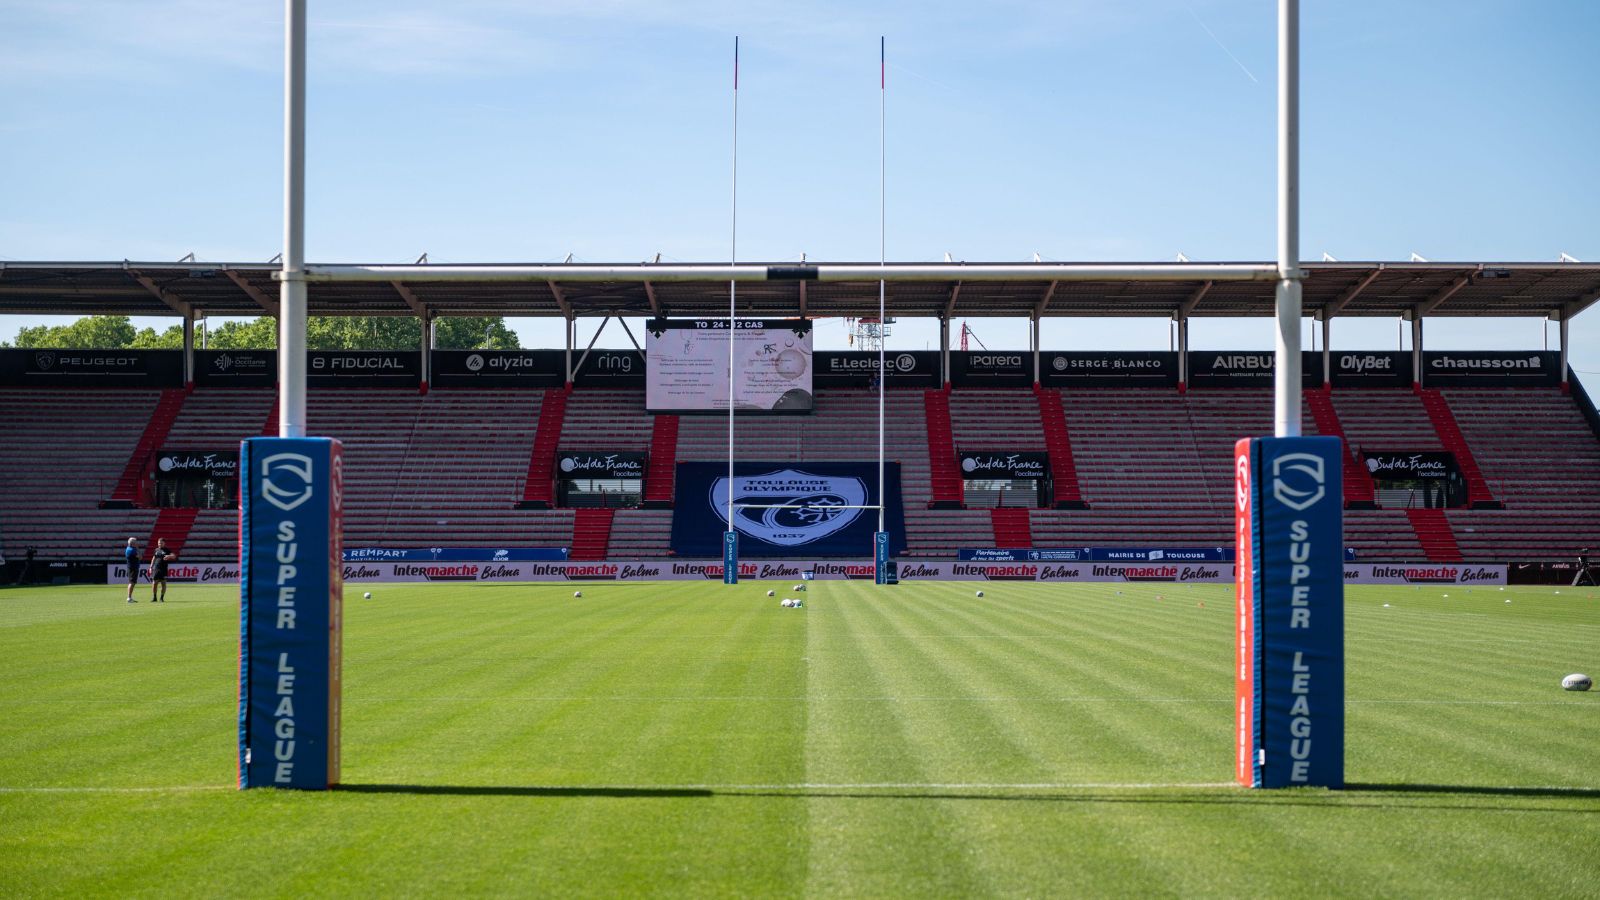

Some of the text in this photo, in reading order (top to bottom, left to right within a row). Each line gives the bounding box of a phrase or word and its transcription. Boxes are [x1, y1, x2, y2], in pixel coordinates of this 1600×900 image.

[59, 357, 138, 366] PEUGEOT
[331, 356, 405, 368] FIDUCIAL
[489, 355, 533, 370] alyzia
[598, 353, 632, 372] ring
[973, 356, 1022, 365] Parera
[1071, 359, 1161, 368] SERGE BLANCO
[1212, 356, 1275, 369] AIRBU
[1340, 355, 1391, 372] OlyBet
[1432, 356, 1529, 368] chausson
[172, 456, 190, 470] Sud
[573, 454, 642, 470] Sud de France
[975, 454, 1043, 470] Sud de France
[1377, 454, 1446, 470] Sud de France
[351, 549, 408, 558] REMPART
[343, 565, 380, 580] Balma
[393, 564, 478, 580] Intermarché
[480, 565, 520, 579] Balma
[533, 563, 618, 580] Intermarché
[620, 565, 660, 579] Balma
[760, 564, 799, 578] Balma
[900, 565, 940, 578] Balma
[952, 564, 1038, 580] Intermarché
[1040, 565, 1080, 580] Balma
[1092, 565, 1178, 581] Intermarché
[1180, 566, 1219, 580] Balma
[1372, 566, 1458, 582] Intermarché
[1460, 567, 1499, 582] Balma
[274, 520, 297, 783] SUPER LEAGUE
[1289, 520, 1311, 782] SUPER LEAGUE
